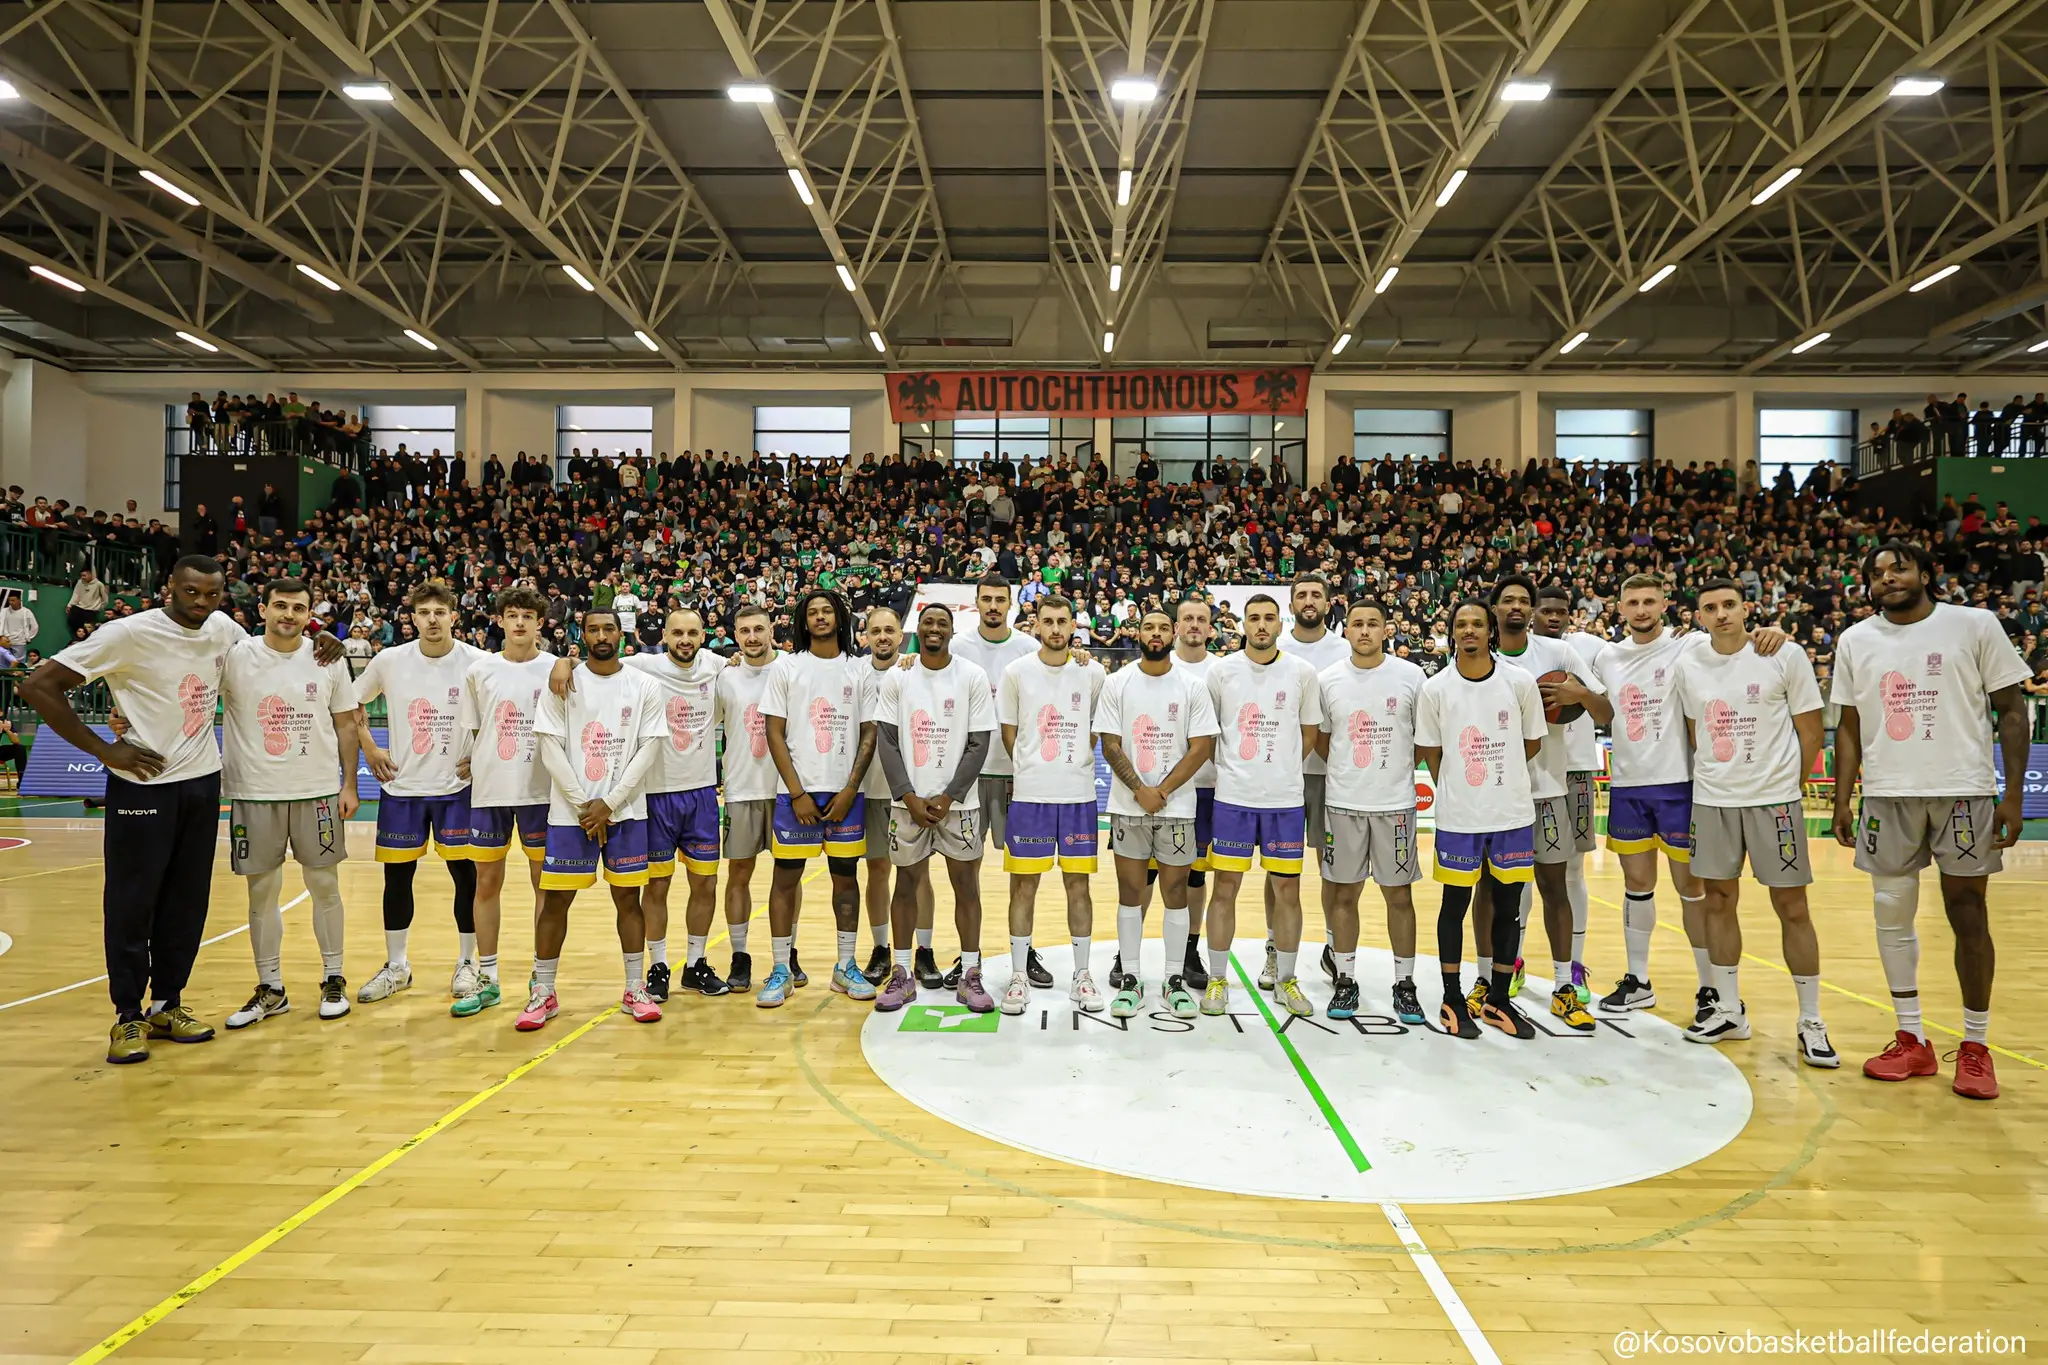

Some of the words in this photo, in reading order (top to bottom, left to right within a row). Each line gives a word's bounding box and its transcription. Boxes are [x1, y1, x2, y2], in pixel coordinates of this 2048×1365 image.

[956, 374, 1239, 411] AUTOCHTHONOUS
[1019, 836, 1056, 845] MERCOM
[1866, 833, 1877, 855] 9
